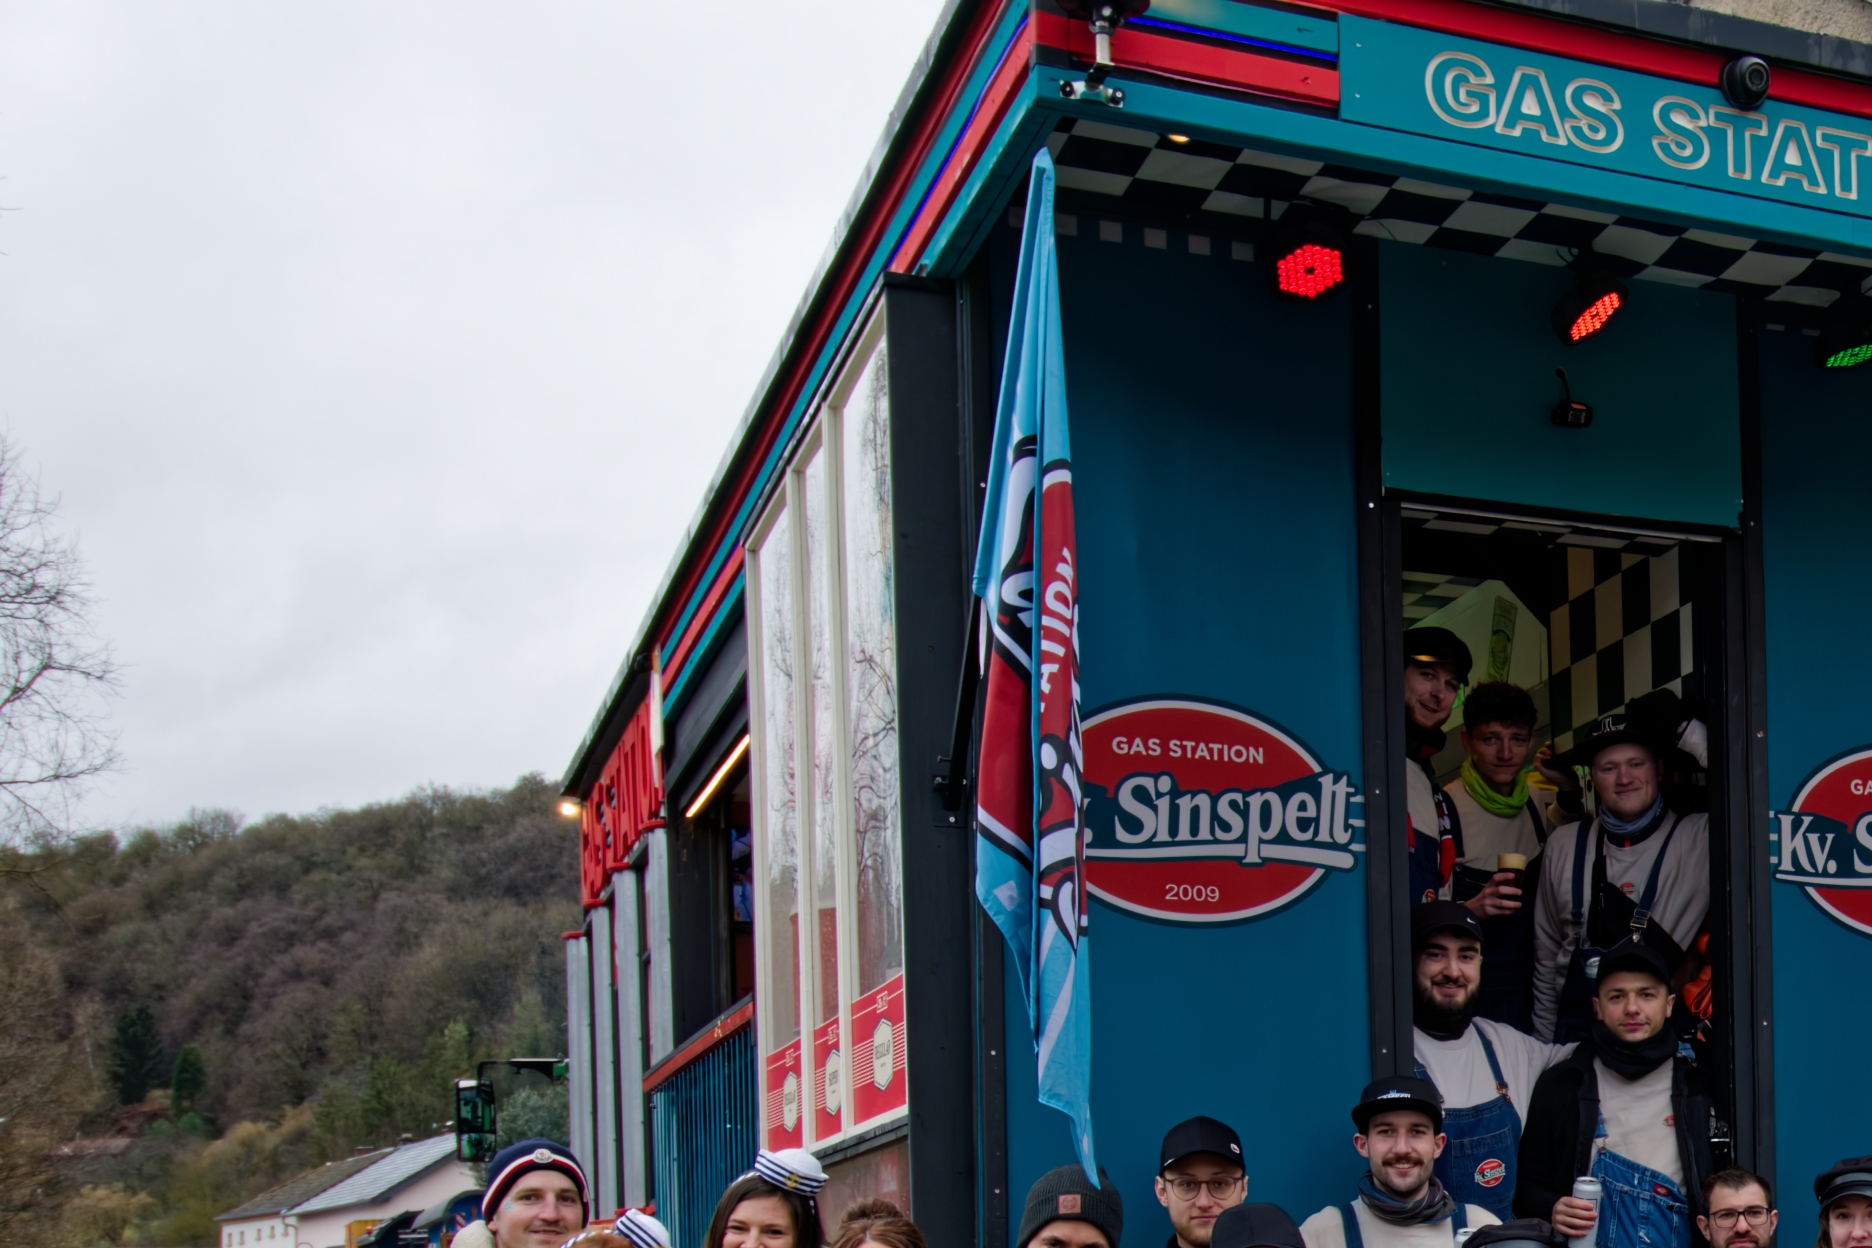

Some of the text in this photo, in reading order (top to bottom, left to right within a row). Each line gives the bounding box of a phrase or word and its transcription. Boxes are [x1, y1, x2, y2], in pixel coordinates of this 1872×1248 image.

[1424, 50, 1625, 154] GAS
[1112, 736, 1264, 765] GAS STATION
[1114, 772, 1356, 863] Sinspelt
[1777, 814, 1838, 874] Kv.
[1164, 884, 1220, 902] 2009
